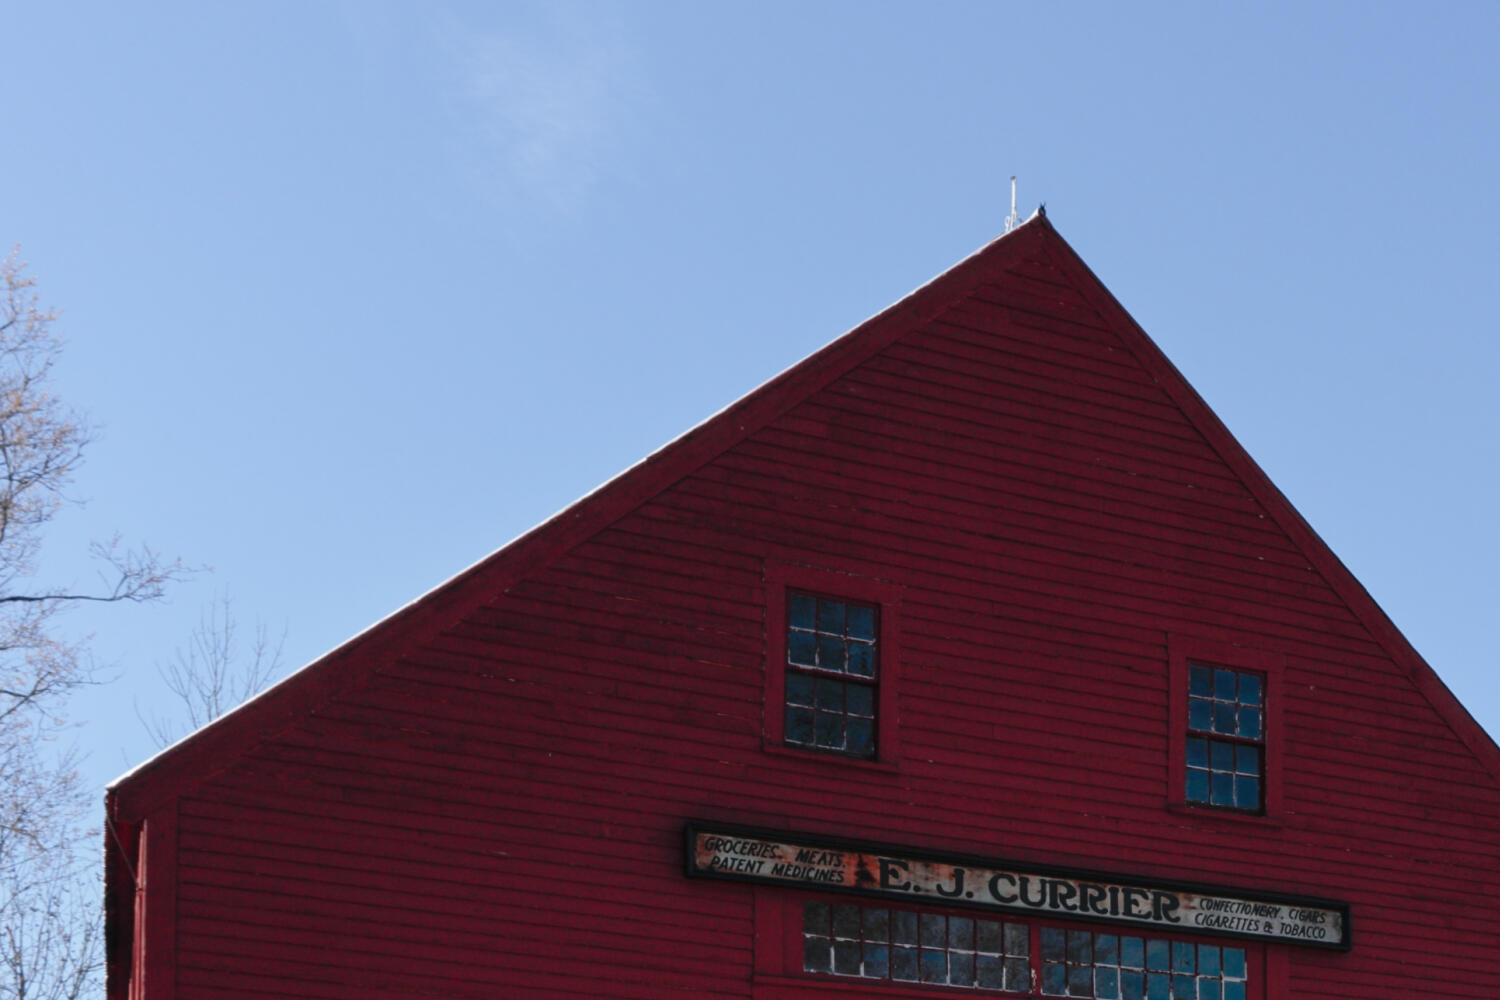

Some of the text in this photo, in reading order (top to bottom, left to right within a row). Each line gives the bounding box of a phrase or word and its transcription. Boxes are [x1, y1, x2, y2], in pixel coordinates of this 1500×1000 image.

[711, 856, 845, 884] PATENT MEDICINES
[878, 857, 1181, 923] E. J. CURRIER
[1194, 912, 1326, 939] CIGARETTES & TOBACCO
[1289, 909, 1327, 924] CIGARS
